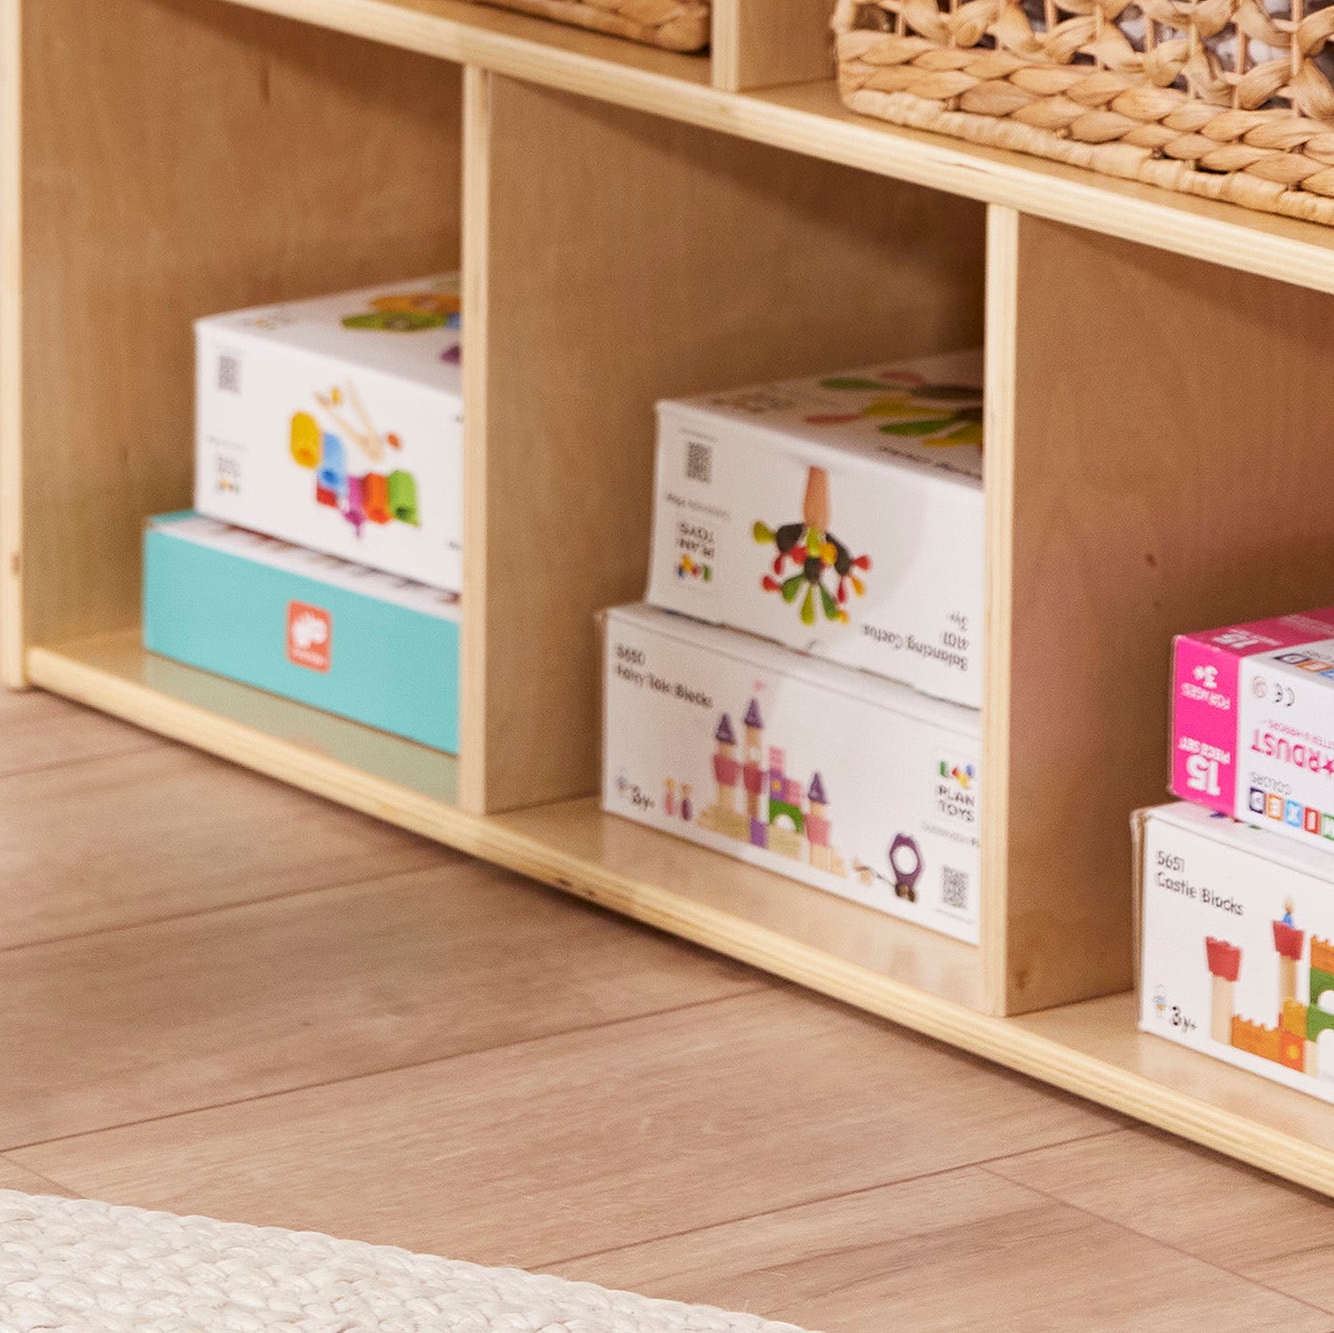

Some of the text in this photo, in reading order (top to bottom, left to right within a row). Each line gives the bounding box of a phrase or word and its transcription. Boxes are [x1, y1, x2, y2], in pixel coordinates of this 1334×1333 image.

[862, 623, 968, 671] Balancing Cactus
[1192, 665, 1218, 689] 3+
[1186, 754, 1221, 796] 15
[937, 785, 975, 806] PLAN
[938, 800, 975, 822] TOYS
[1157, 850, 1185, 872] 5651
[1155, 871, 1243, 915] Castle Blocks
